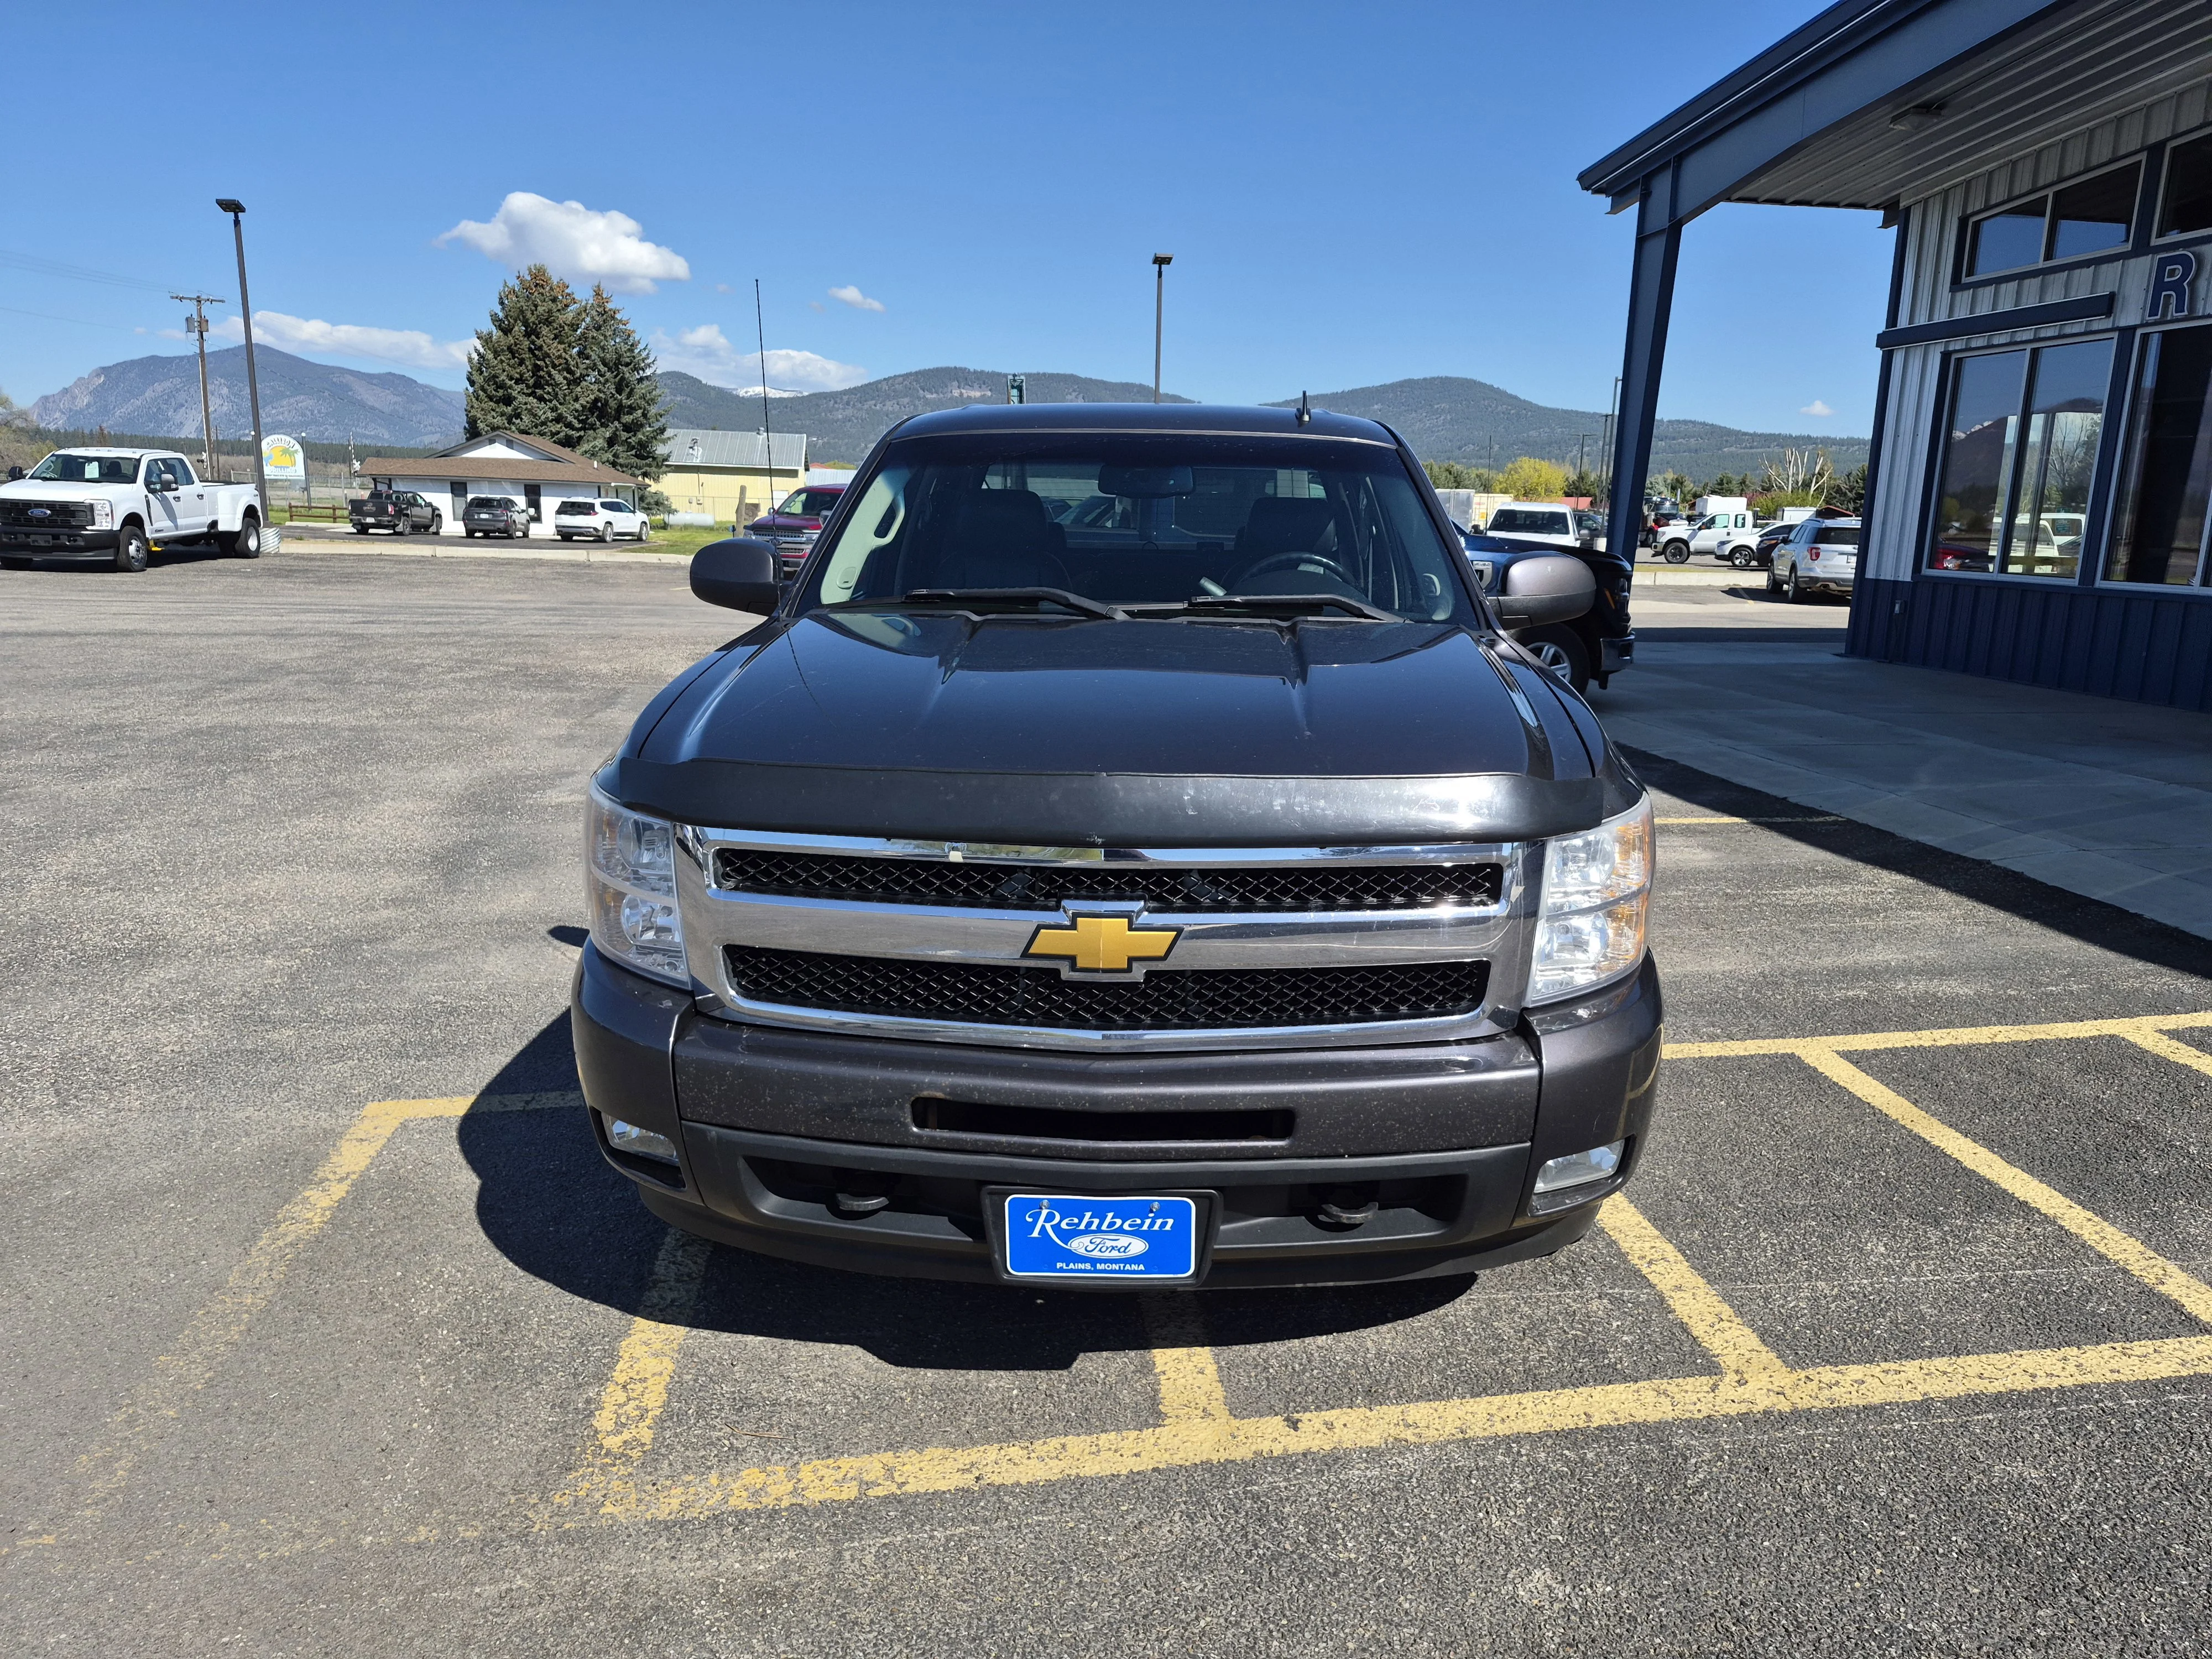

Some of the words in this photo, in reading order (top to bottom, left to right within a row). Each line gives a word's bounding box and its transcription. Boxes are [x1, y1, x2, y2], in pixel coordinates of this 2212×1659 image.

[2146, 251, 2197, 320] R
[1025, 1208, 1175, 1250] Rehbein
[1084, 1237, 1131, 1255] Ford
[1056, 1262, 1094, 1271] PLAINS,
[1097, 1262, 1145, 1271] MONTANA
